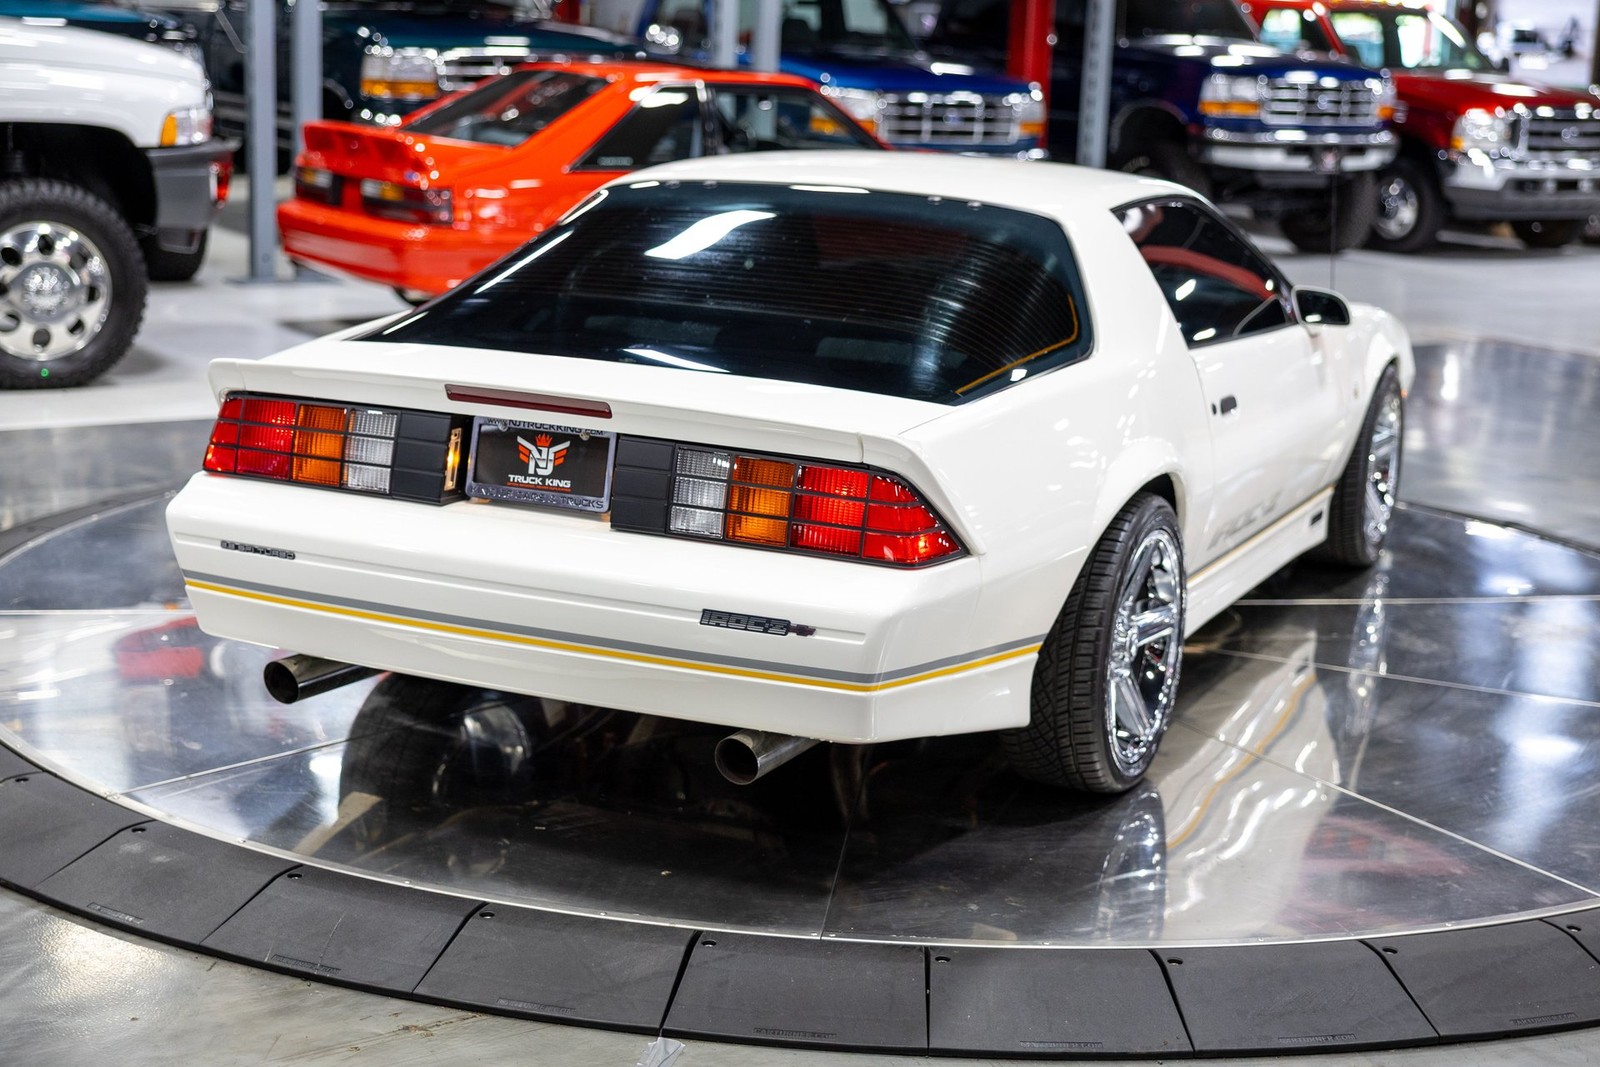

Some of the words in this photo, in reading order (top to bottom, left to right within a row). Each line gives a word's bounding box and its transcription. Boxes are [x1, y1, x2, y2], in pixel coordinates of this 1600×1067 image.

[508, 474, 543, 486] TRUCK
[545, 478, 571, 488] KING
[560, 496, 604, 509] TRUCKS
